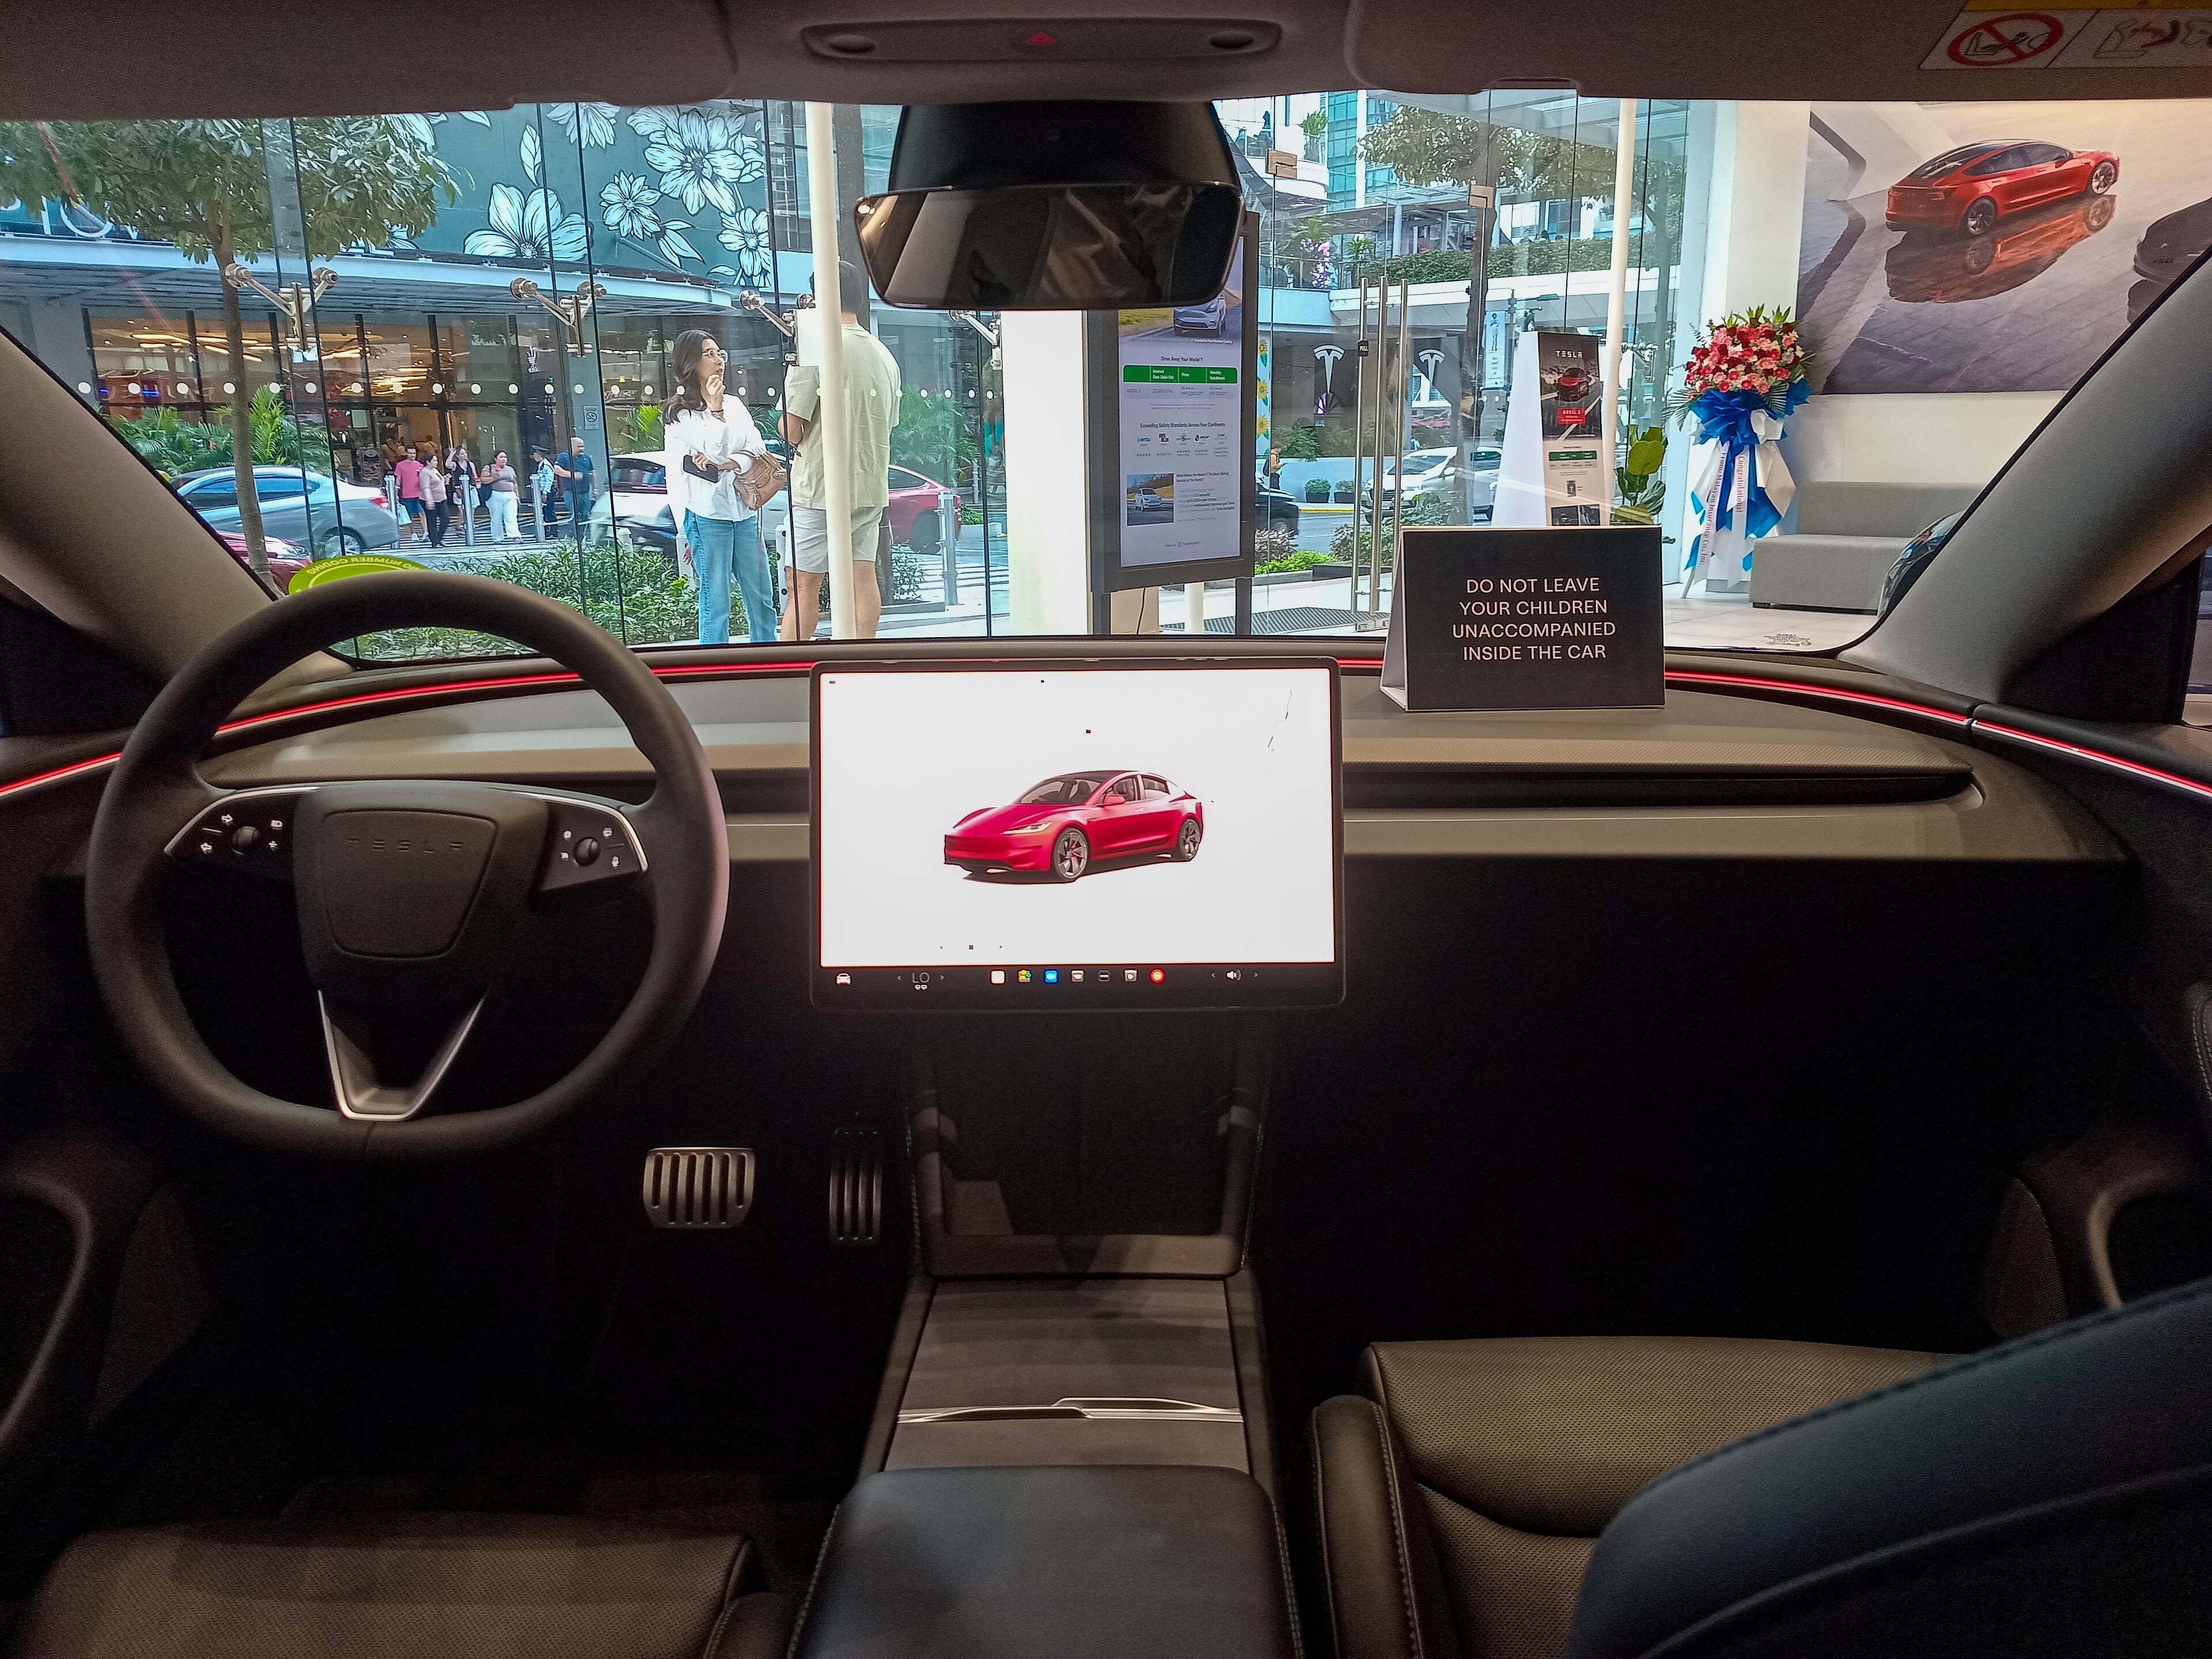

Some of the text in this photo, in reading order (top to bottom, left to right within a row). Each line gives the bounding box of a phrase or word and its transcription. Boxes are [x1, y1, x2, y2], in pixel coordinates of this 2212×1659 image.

[1718, 452, 1727, 474] From:
[1711, 474, 1722, 504] Malayan
[1736, 456, 1745, 513] Congratulations!
[1705, 503, 1715, 539] Insurance
[1699, 553, 1708, 565] Inc.
[1467, 577, 1600, 593] DO NOT LEAVE
[1459, 600, 1607, 616] YOUR CHILDREN
[1453, 622, 1616, 638] UNACCOMPANIED
[1464, 645, 1606, 660] INSIDE THE CAR
[348, 839, 463, 853] TESLA
[912, 971, 930, 983] LO
